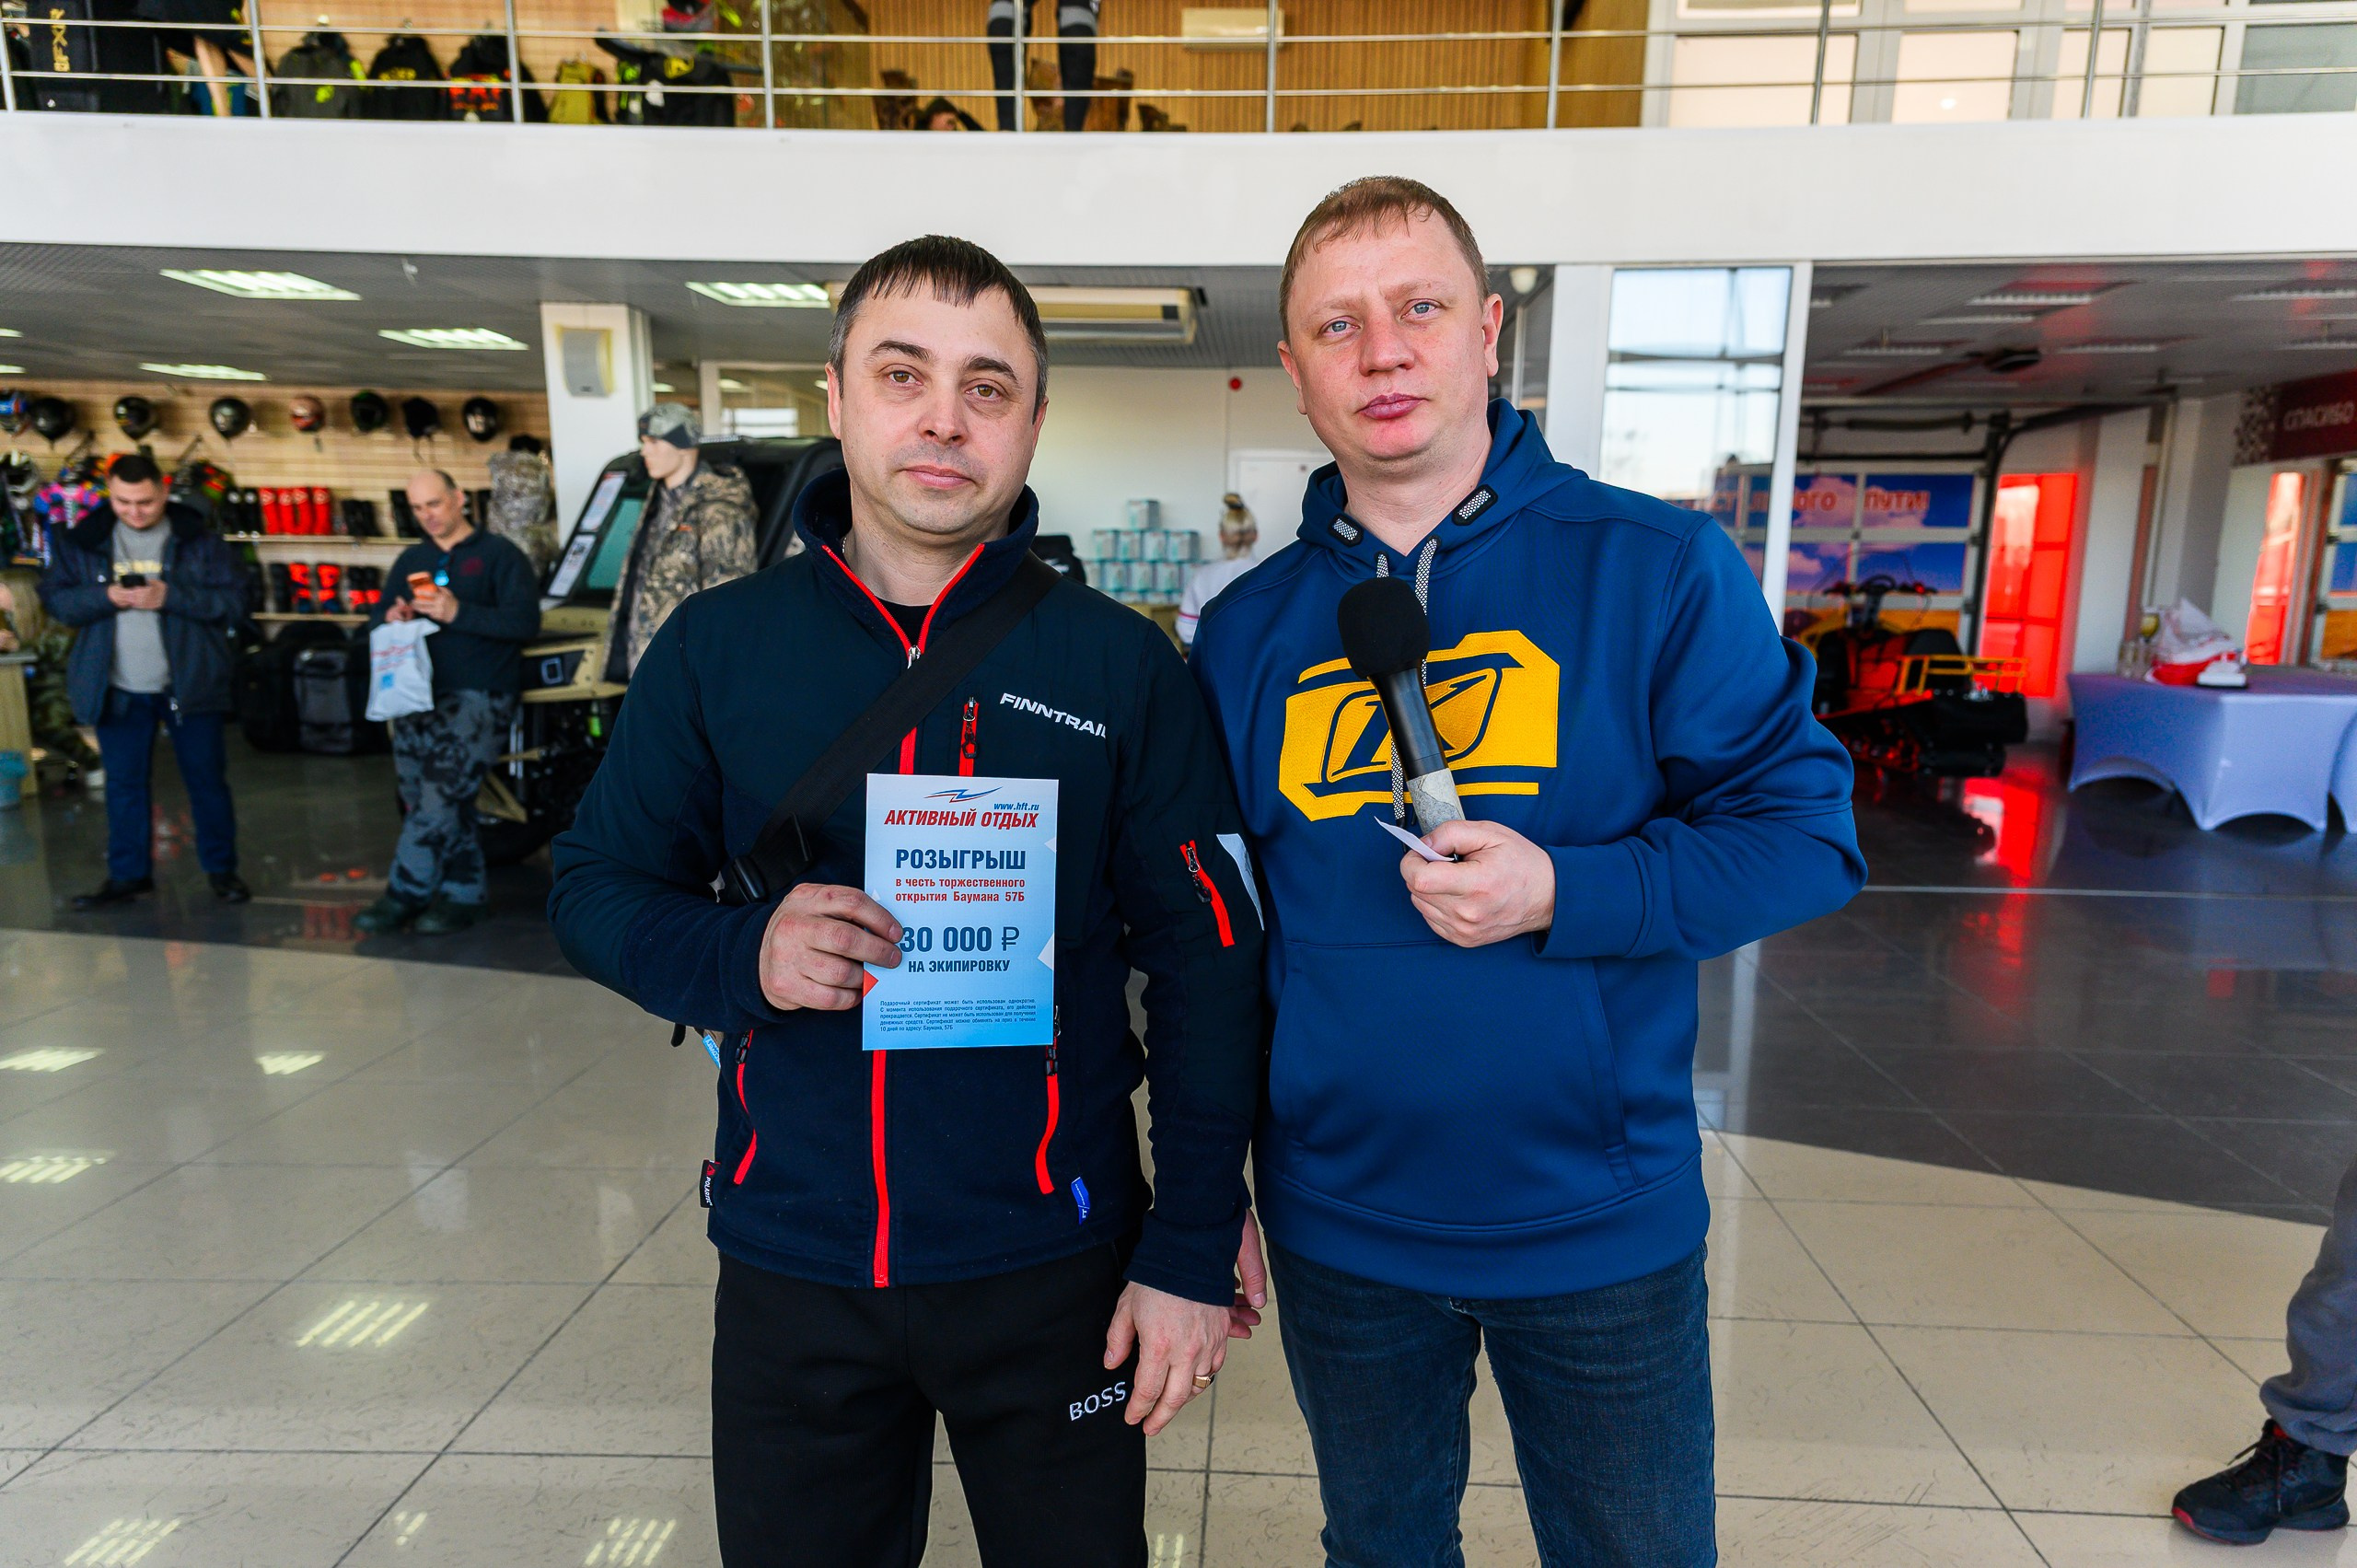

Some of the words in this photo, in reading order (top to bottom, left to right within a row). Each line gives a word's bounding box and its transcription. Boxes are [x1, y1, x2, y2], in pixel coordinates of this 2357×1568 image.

[993, 803, 1039, 811] www.hft.ru
[884, 808, 977, 827] АКТИВНЫЙ
[981, 811, 1039, 830] ОТДЫХ
[896, 849, 1026, 870] РОЗЫГРЫШ
[895, 878, 901, 887] в
[905, 878, 935, 887] честь
[939, 878, 1026, 889] торжественного
[895, 893, 947, 903] открытия
[953, 891, 1000, 903] Баумана
[1004, 891, 1025, 901] 57Б
[899, 926, 933, 952] 30
[943, 926, 993, 952] 000
[908, 960, 924, 972] НА
[928, 959, 1010, 972] ЭКИПИРОВКУ
[1069, 1381, 1126, 1421] BOSS
